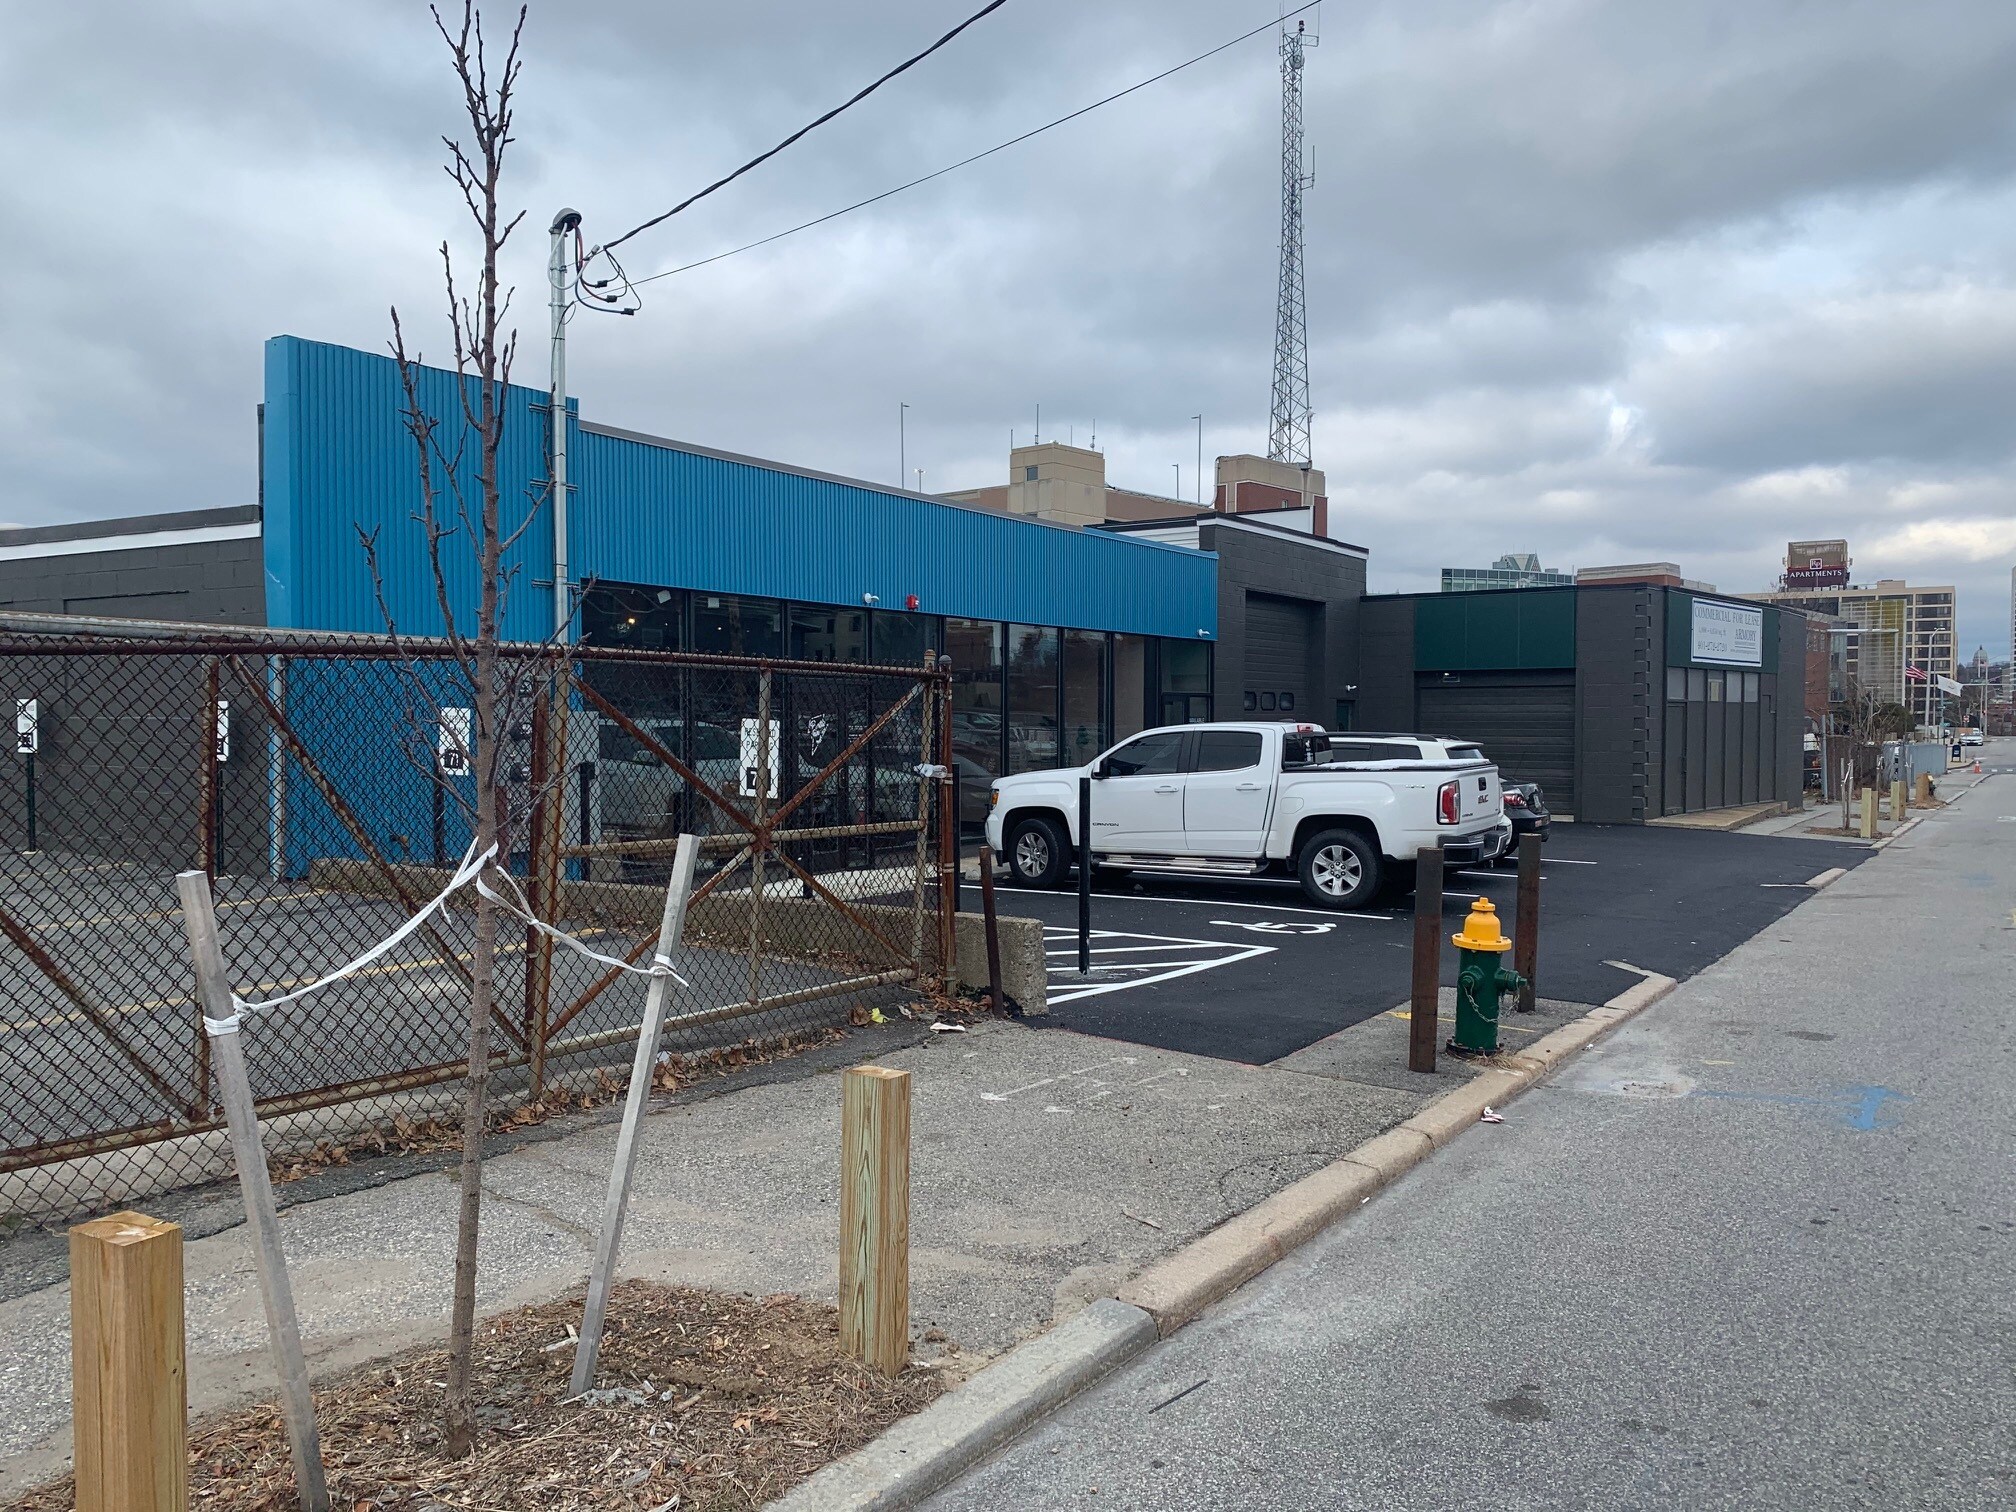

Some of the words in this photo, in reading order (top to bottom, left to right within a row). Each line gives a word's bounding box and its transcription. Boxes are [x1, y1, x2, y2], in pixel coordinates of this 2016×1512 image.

[1790, 570, 1842, 578] APARTMENTS
[1695, 606, 1731, 623] COMMERCIAL
[1732, 612, 1744, 624] FOR
[1745, 613, 1760, 626] LEASE
[1734, 629, 1757, 642] ARMORY
